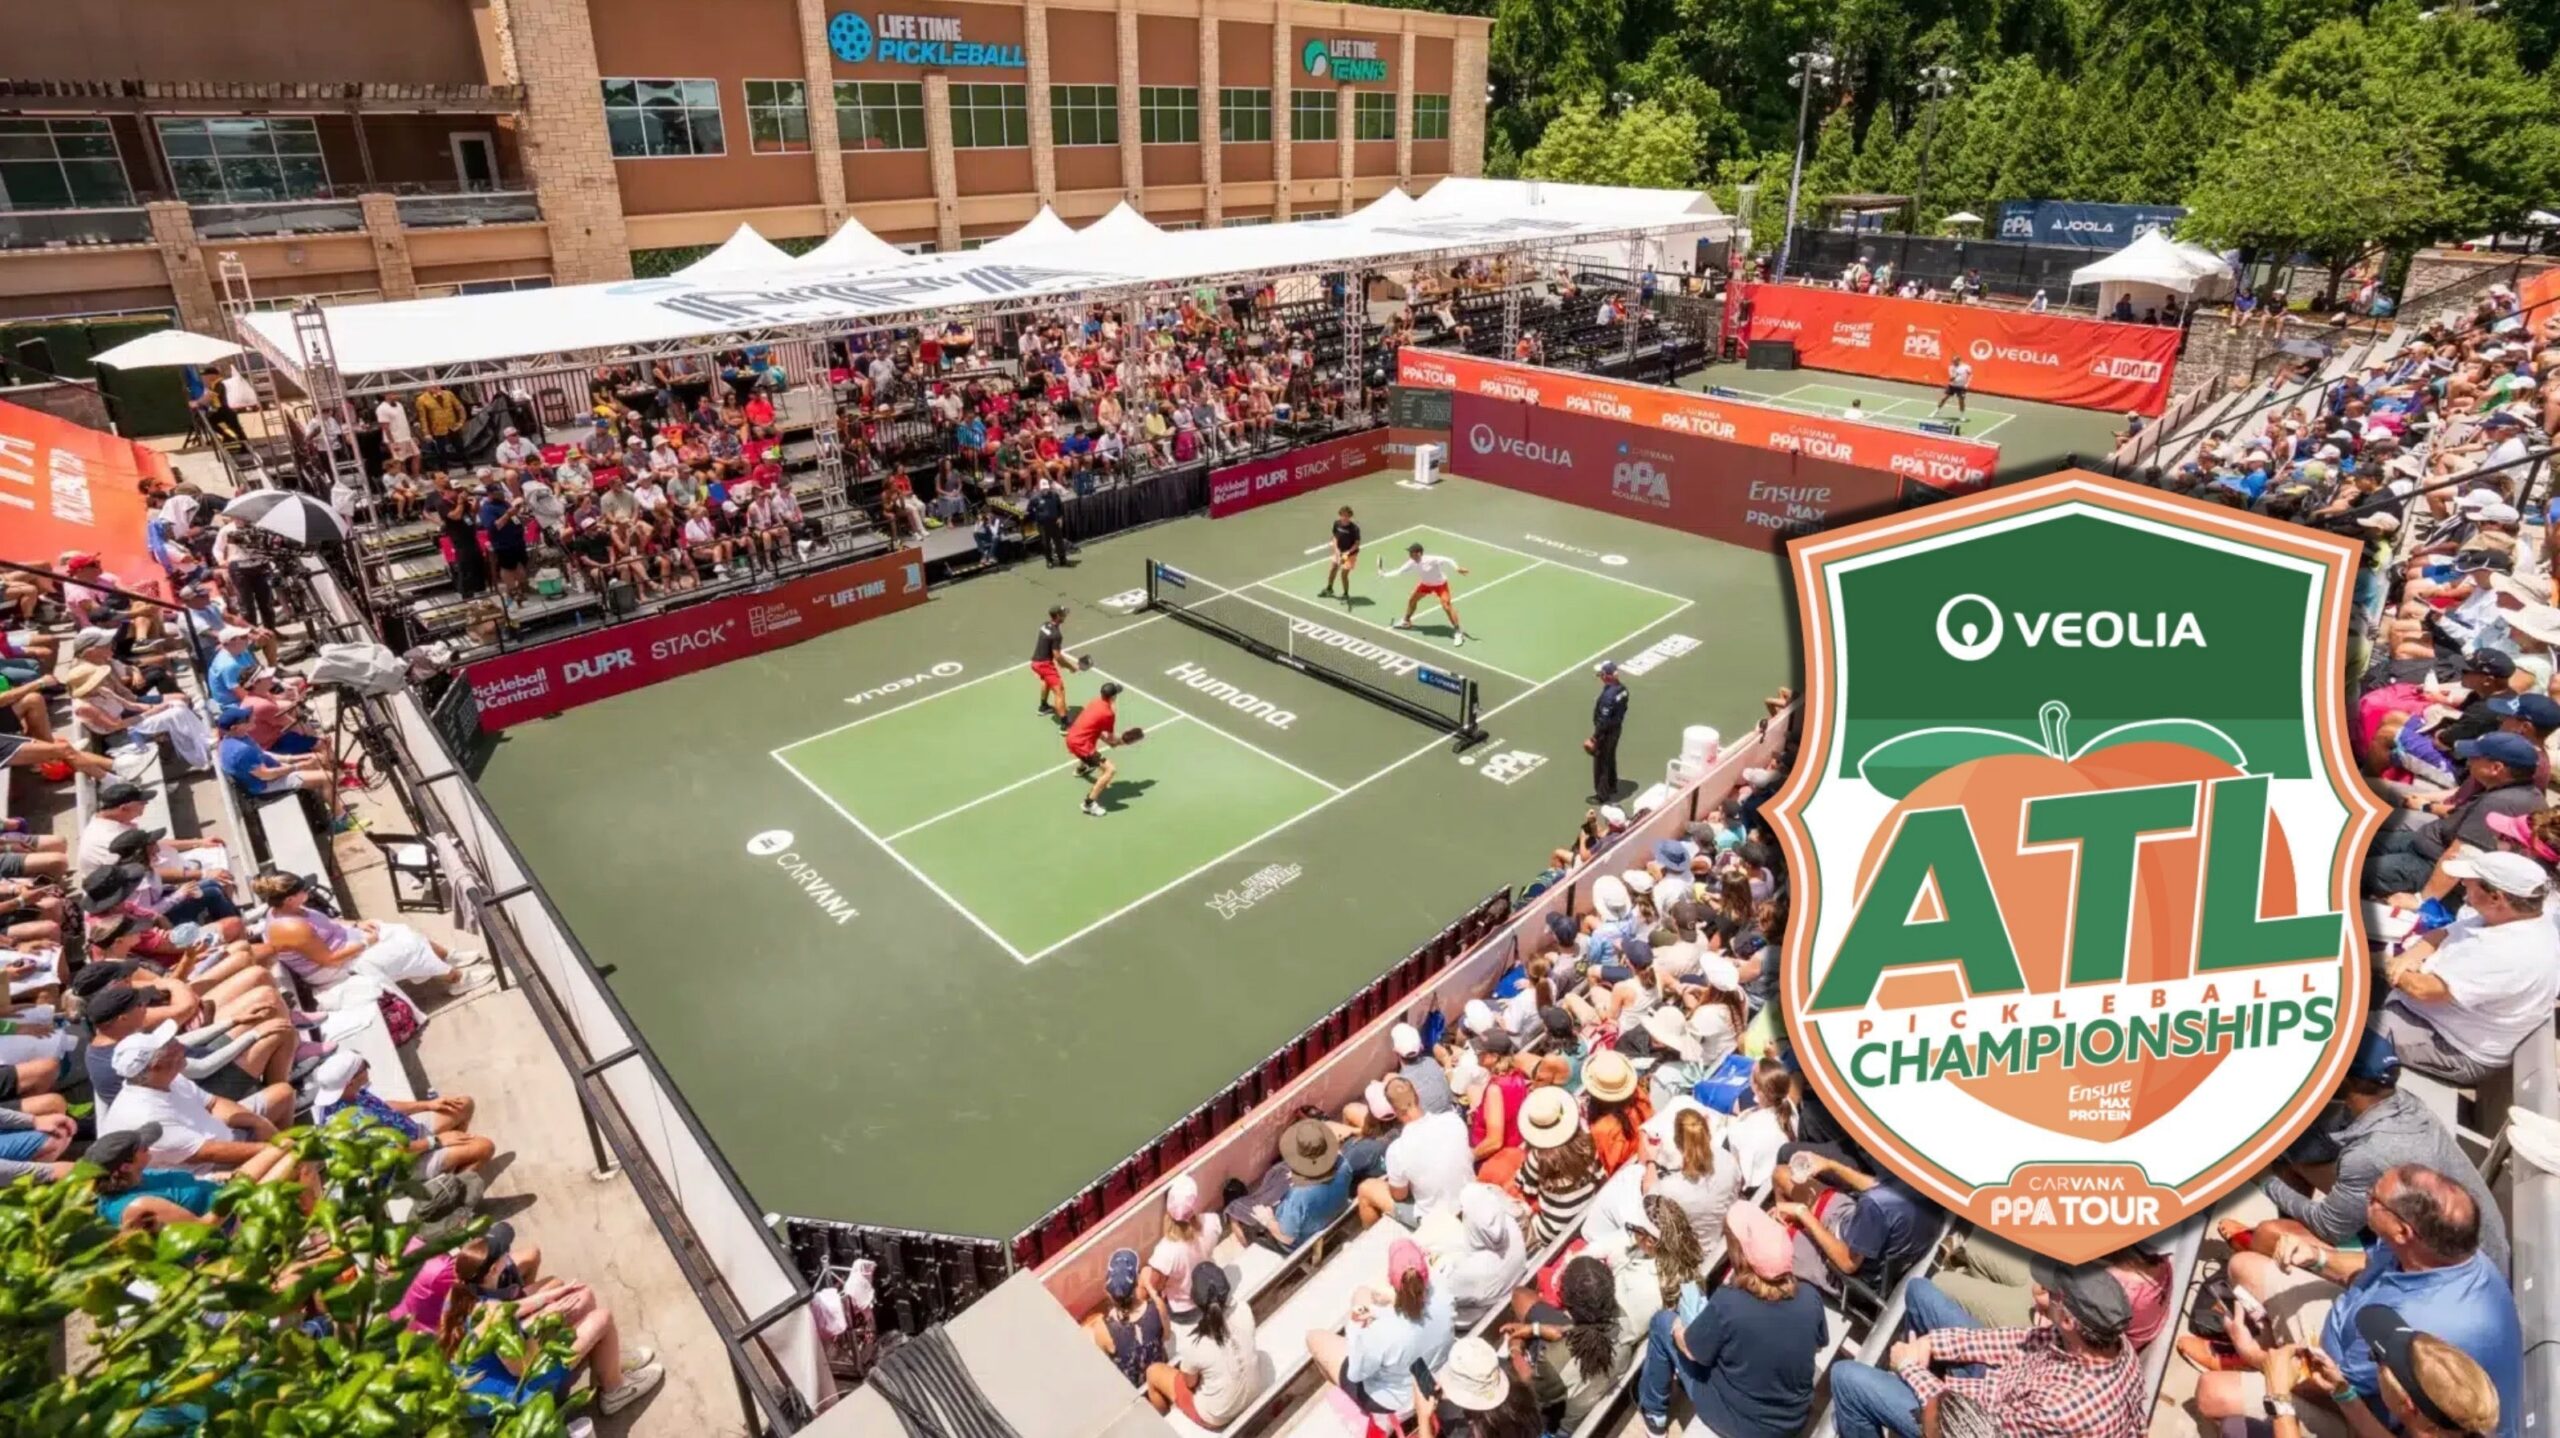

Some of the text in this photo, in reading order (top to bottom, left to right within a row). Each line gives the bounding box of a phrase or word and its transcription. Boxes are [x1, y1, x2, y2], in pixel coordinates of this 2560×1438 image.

[878, 14, 962, 41] LIFE TIME
[878, 40, 1026, 67] PICKLEBALL
[1330, 39, 1377, 59] LIFE TIME
[1331, 59, 1387, 81] TENNIS
[2002, 216, 2033, 233] PPA
[2062, 220, 2115, 233] JOOLA
[1752, 315, 1802, 330] CARVANA
[1904, 334, 1941, 356] PPA
[1994, 347, 2060, 366] VEOLIA
[1403, 366, 1456, 387] PPA TOUR
[2113, 359, 2159, 379] JOOLA
[1480, 379, 1540, 402] PPA TOUR
[1566, 395, 1632, 419] PPA TOUR
[1661, 412, 1735, 440] PPA TOUR
[1788, 424, 1837, 441] CARVANA
[1499, 435, 1573, 468] VEOLIA
[1769, 431, 1853, 461] PPA TOUR
[1913, 447, 1967, 465] CARVANA
[1255, 469, 1288, 490] DUPR
[1890, 454, 1985, 485] PPA TOUR
[1612, 461, 1670, 502] PPA
[1749, 480, 1831, 503] Ensure
[1786, 503, 1827, 521] MAX
[830, 590, 856, 608] LIFE
[857, 579, 887, 600] TIME
[651, 625, 727, 661] STACK
[563, 647, 636, 685] DUPR
[485, 683, 545, 710] Central
[843, 673, 933, 705] VEOLIA
[1164, 661, 1298, 730] Humana.
[776, 852, 860, 925] CARVANA
